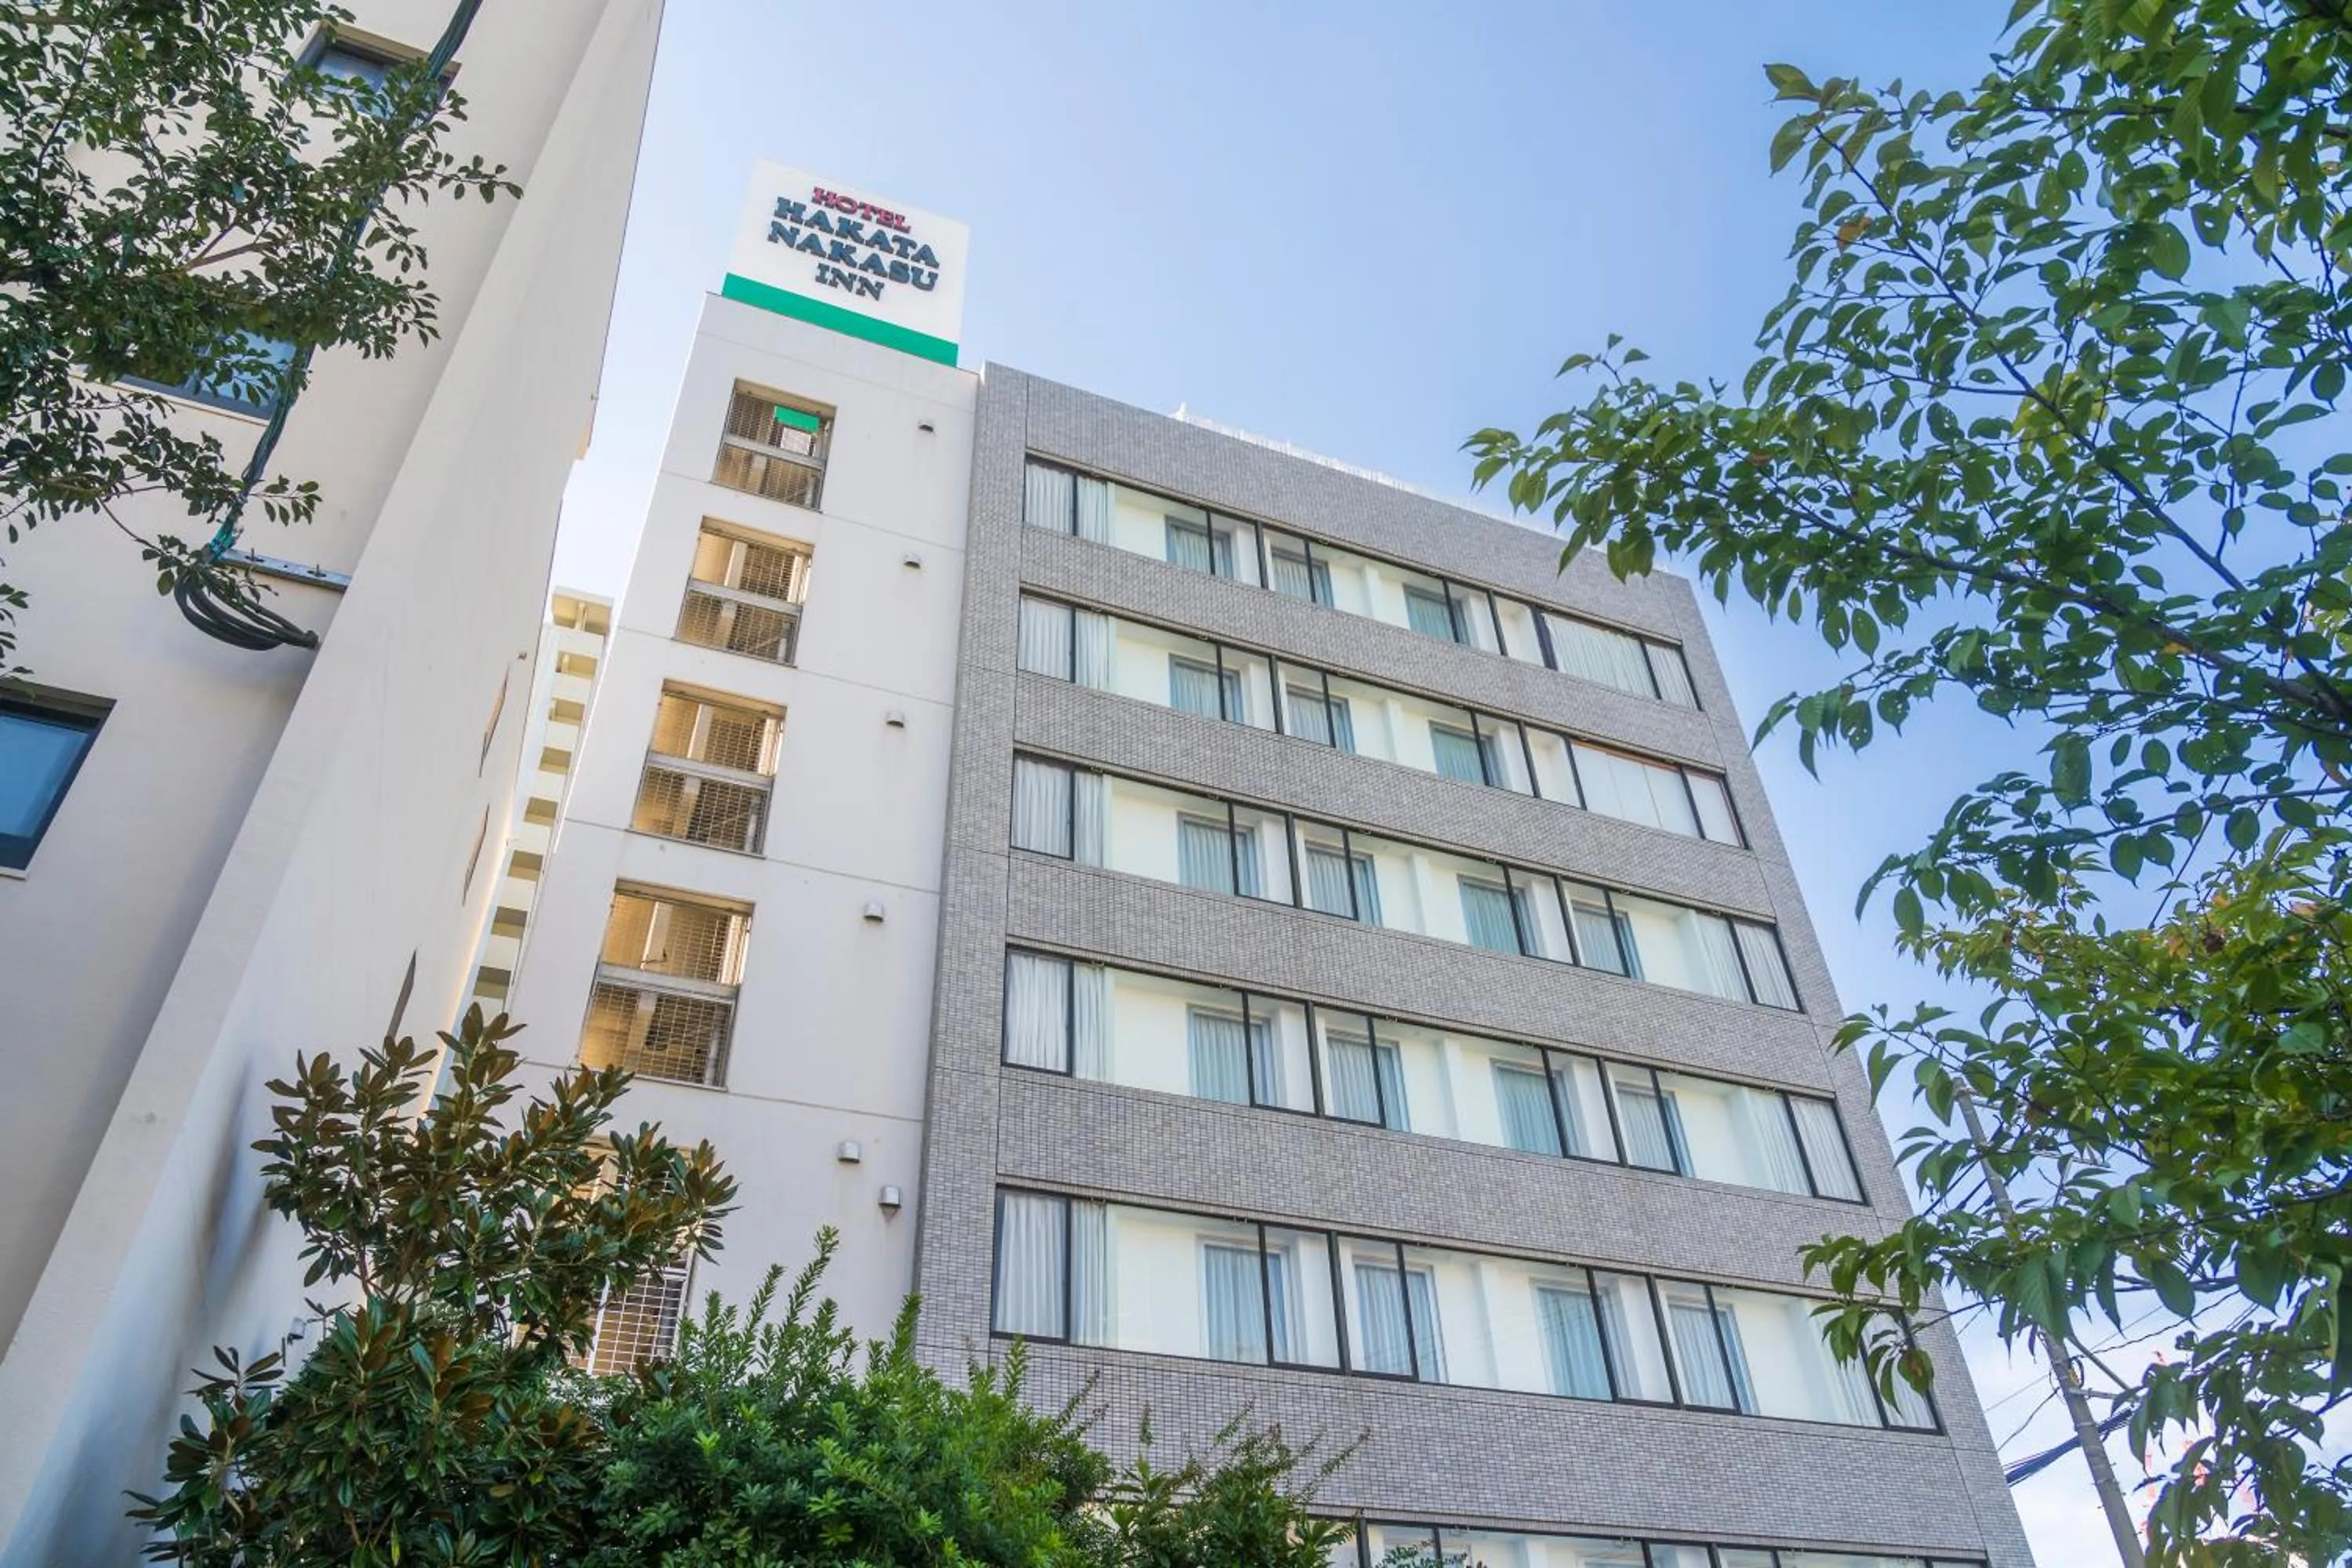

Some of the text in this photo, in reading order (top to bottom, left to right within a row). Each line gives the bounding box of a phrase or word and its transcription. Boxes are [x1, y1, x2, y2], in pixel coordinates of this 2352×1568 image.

[774, 196, 940, 269] HAKATA
[811, 186, 910, 234] HOTEL
[768, 220, 938, 291] NAKASU
[815, 263, 885, 301] INN
